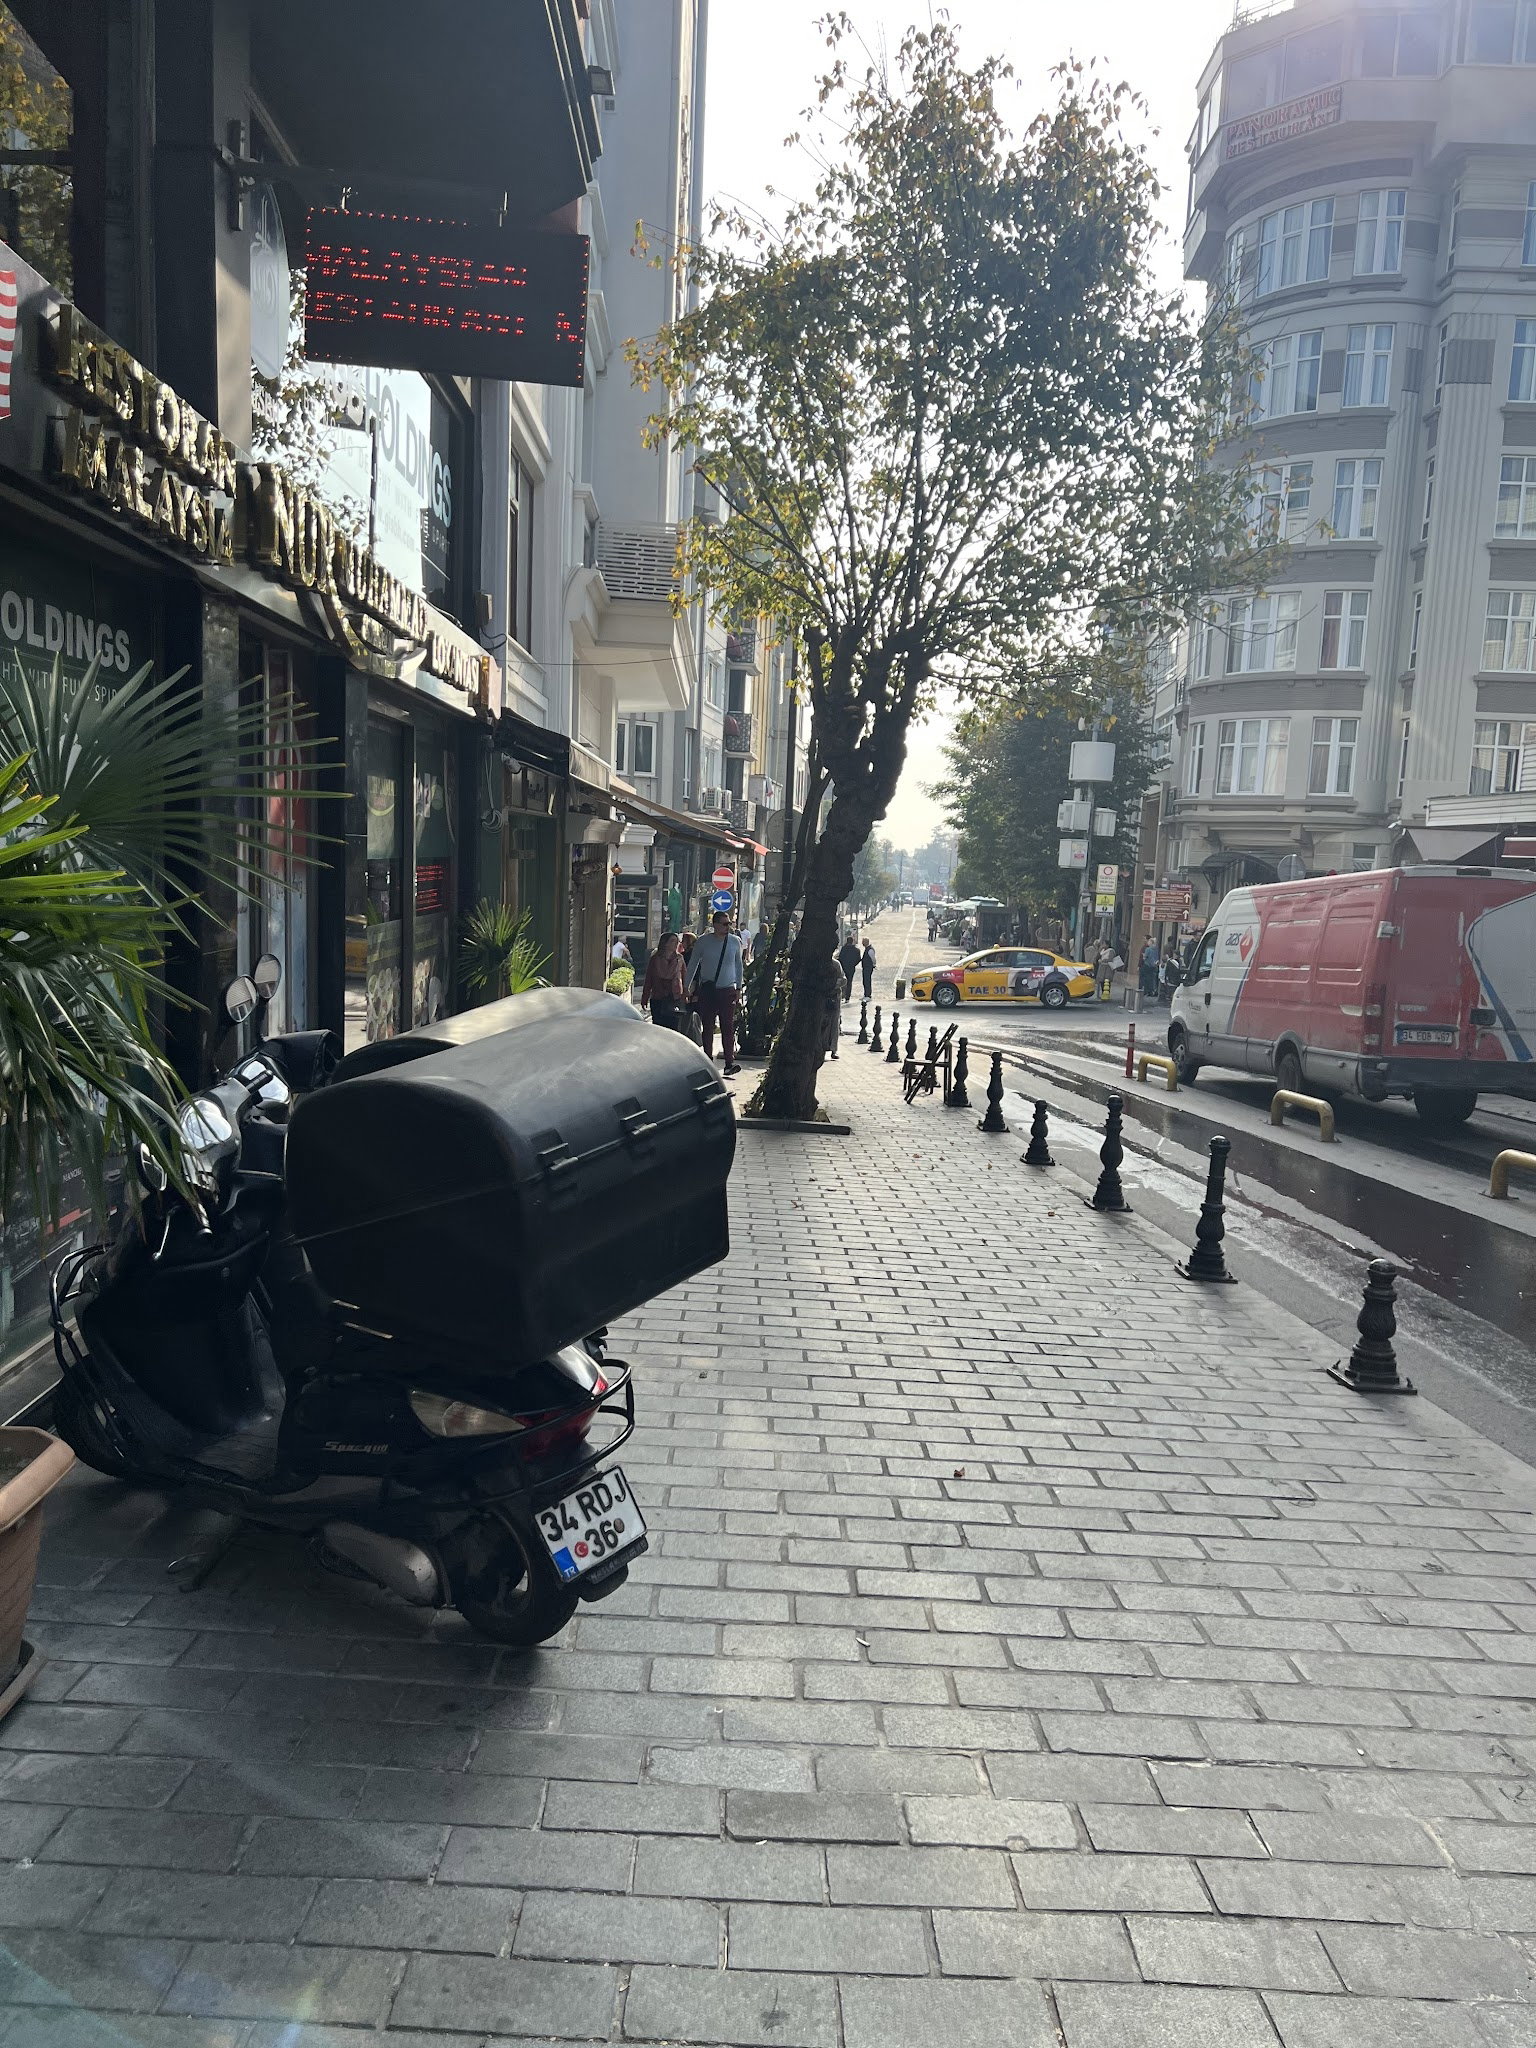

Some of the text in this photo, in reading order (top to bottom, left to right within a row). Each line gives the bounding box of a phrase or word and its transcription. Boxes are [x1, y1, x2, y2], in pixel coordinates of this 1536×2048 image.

[61, 407, 235, 561] MALAYSIA
[967, 985, 1006, 995] TAE 30
[540, 1472, 627, 1541] 34 RDJ
[584, 1520, 619, 1557] 36
[563, 1566, 577, 1578] TR
